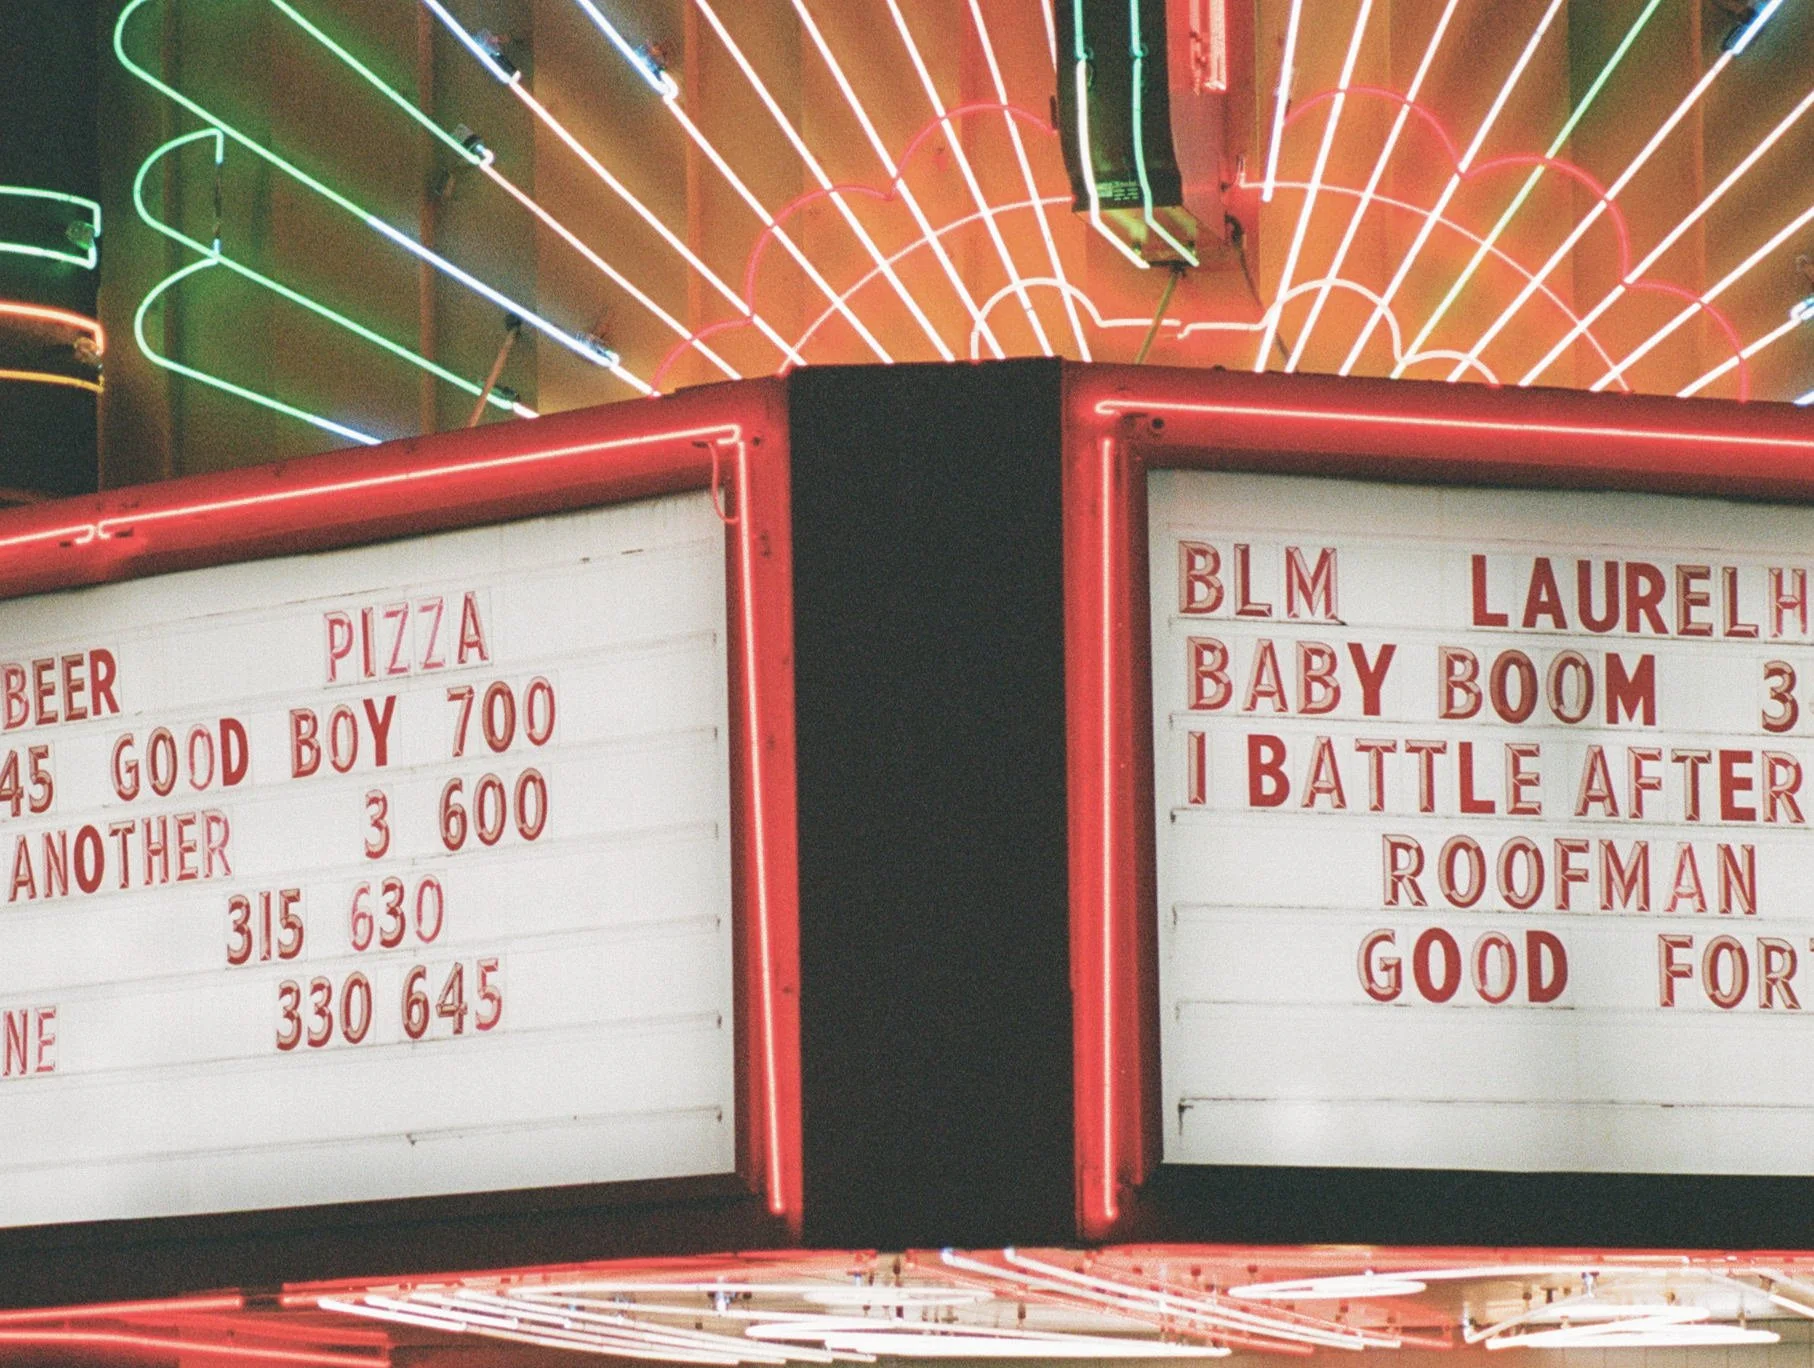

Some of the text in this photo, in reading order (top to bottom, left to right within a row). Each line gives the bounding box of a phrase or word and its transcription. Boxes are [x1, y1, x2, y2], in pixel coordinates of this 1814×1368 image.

[1179, 540, 1808, 639] BLM LAURELH
[1, 591, 490, 731] BEER PIZZA
[1187, 637, 1397, 717] BABY
[1440, 647, 1657, 727] BOOM
[0, 675, 556, 818] 45 GOOD BOY 700
[1189, 731, 1805, 824] I BATTLE AFTER
[8, 768, 549, 902] ANOTHER 3 600
[1382, 834, 1757, 916] ROOFMAN
[227, 874, 444, 965] 315 630
[1357, 927, 1814, 1010] GOOD FOR
[3, 957, 503, 1077] NE 330 645
